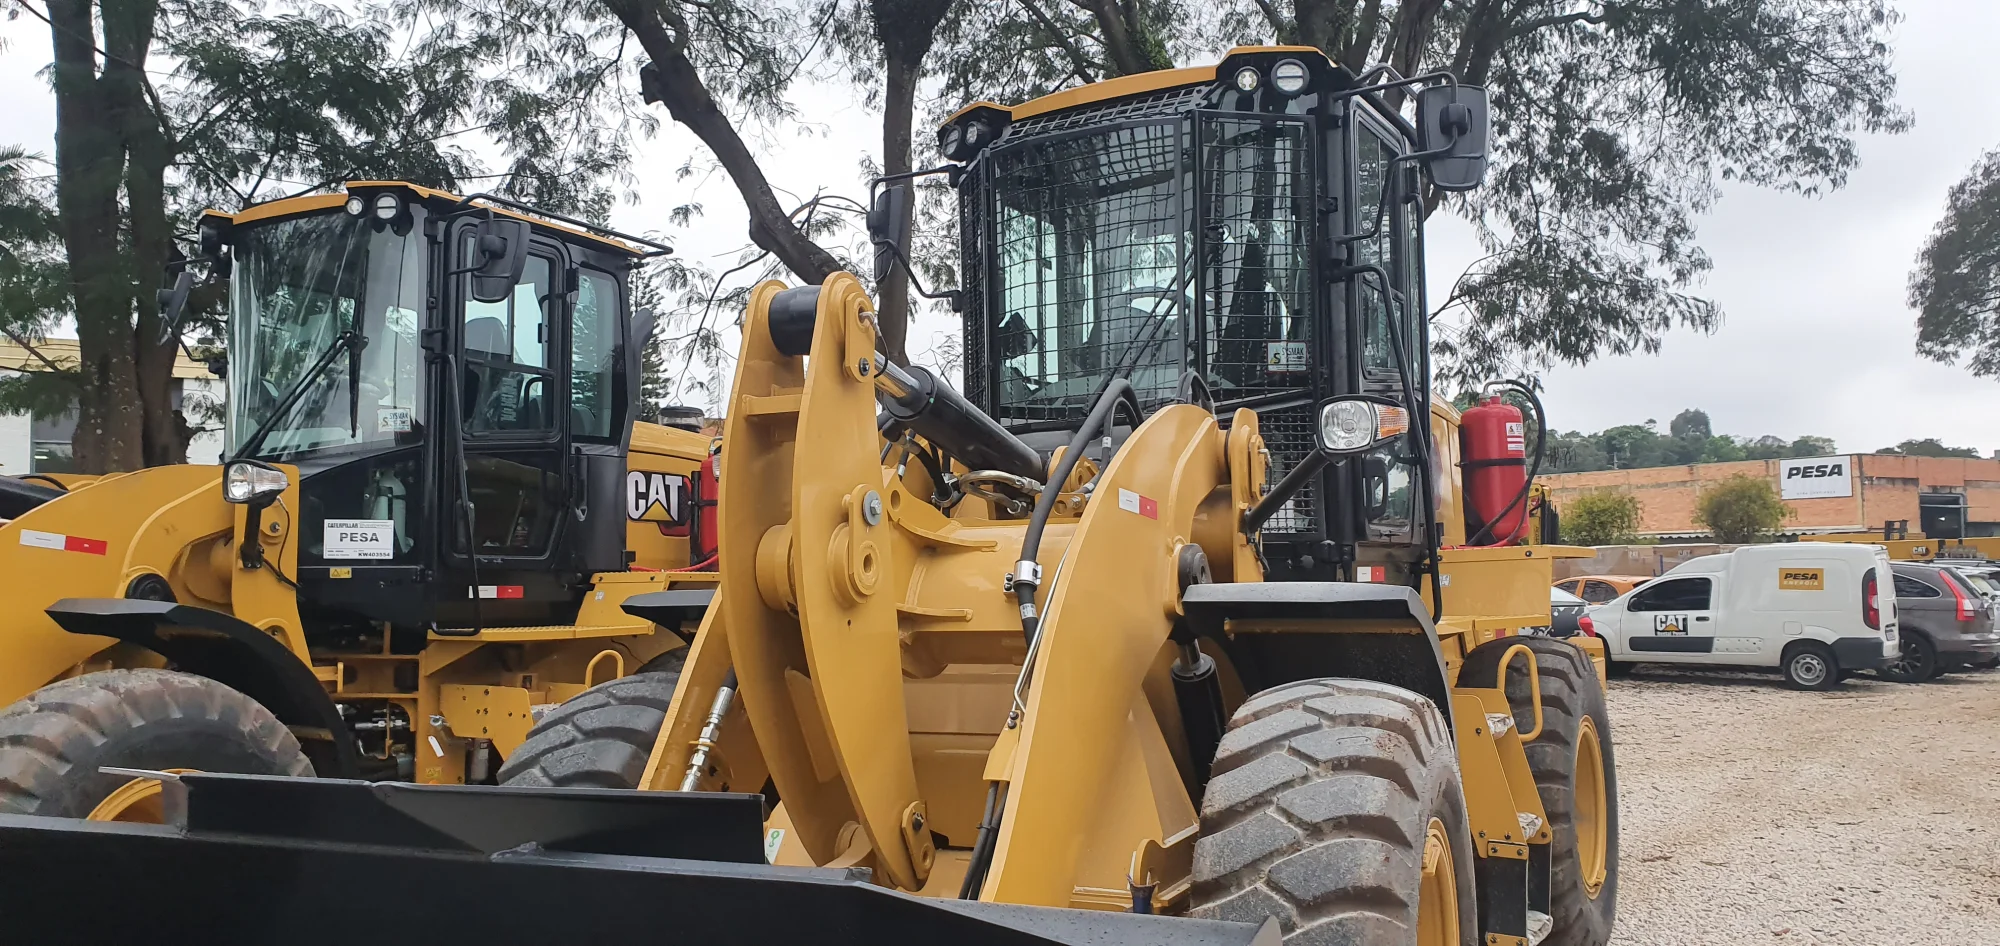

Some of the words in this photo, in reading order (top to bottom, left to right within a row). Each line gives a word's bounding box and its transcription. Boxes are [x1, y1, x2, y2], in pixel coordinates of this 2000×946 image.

[1787, 464, 1843, 479] PESA
[627, 471, 682, 521] CAT
[339, 532, 379, 542] PESA
[1784, 572, 1818, 580] PESA
[1656, 614, 1685, 631] CAT
